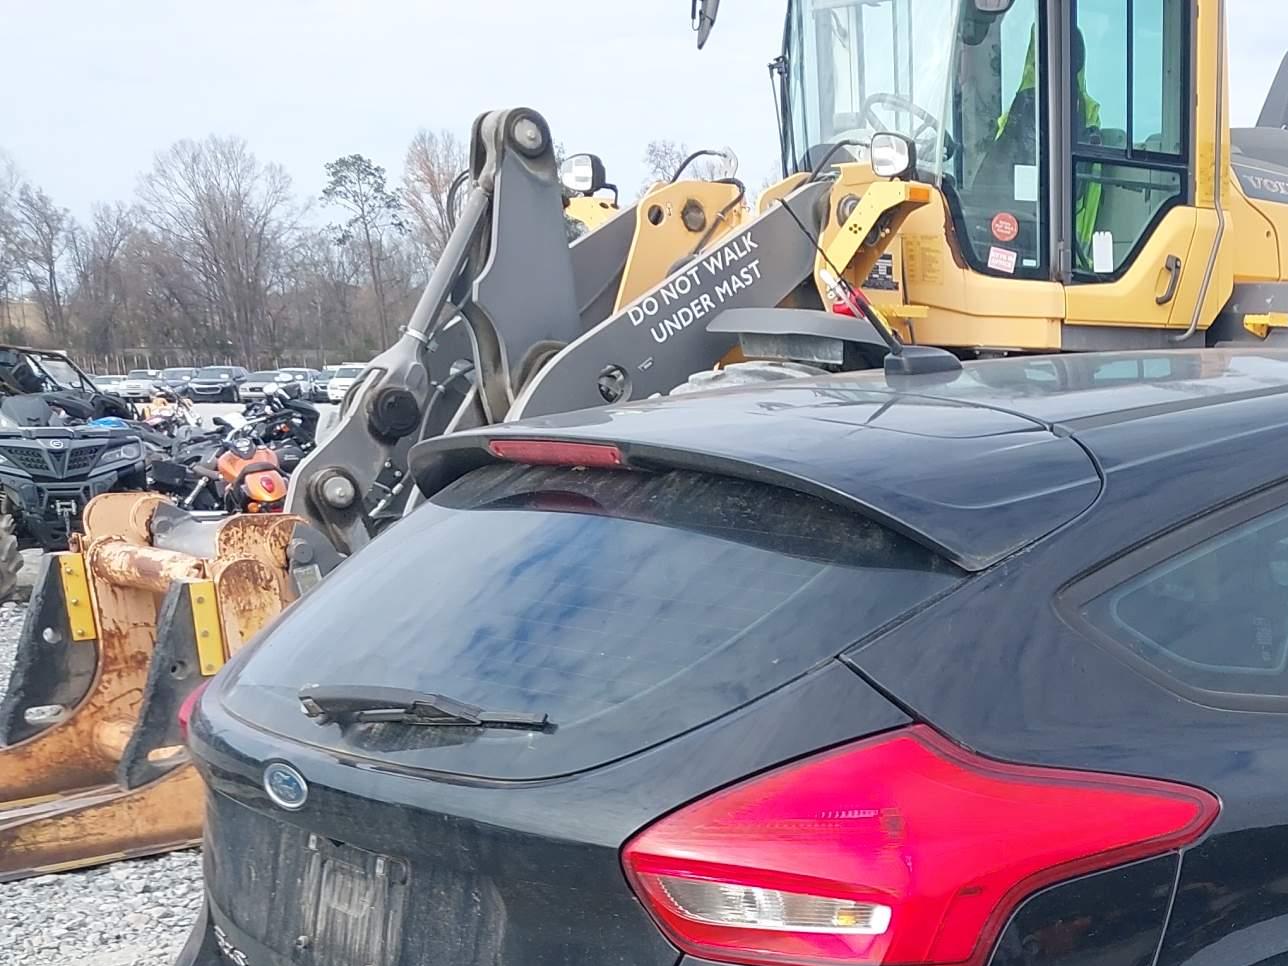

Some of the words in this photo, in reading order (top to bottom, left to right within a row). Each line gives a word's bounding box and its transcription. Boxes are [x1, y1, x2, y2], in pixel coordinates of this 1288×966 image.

[627, 299, 659, 326] DO
[660, 266, 701, 305] NOT
[703, 231, 759, 275] WALK
[651, 293, 716, 343] UNDER
[715, 259, 761, 302] MAST
